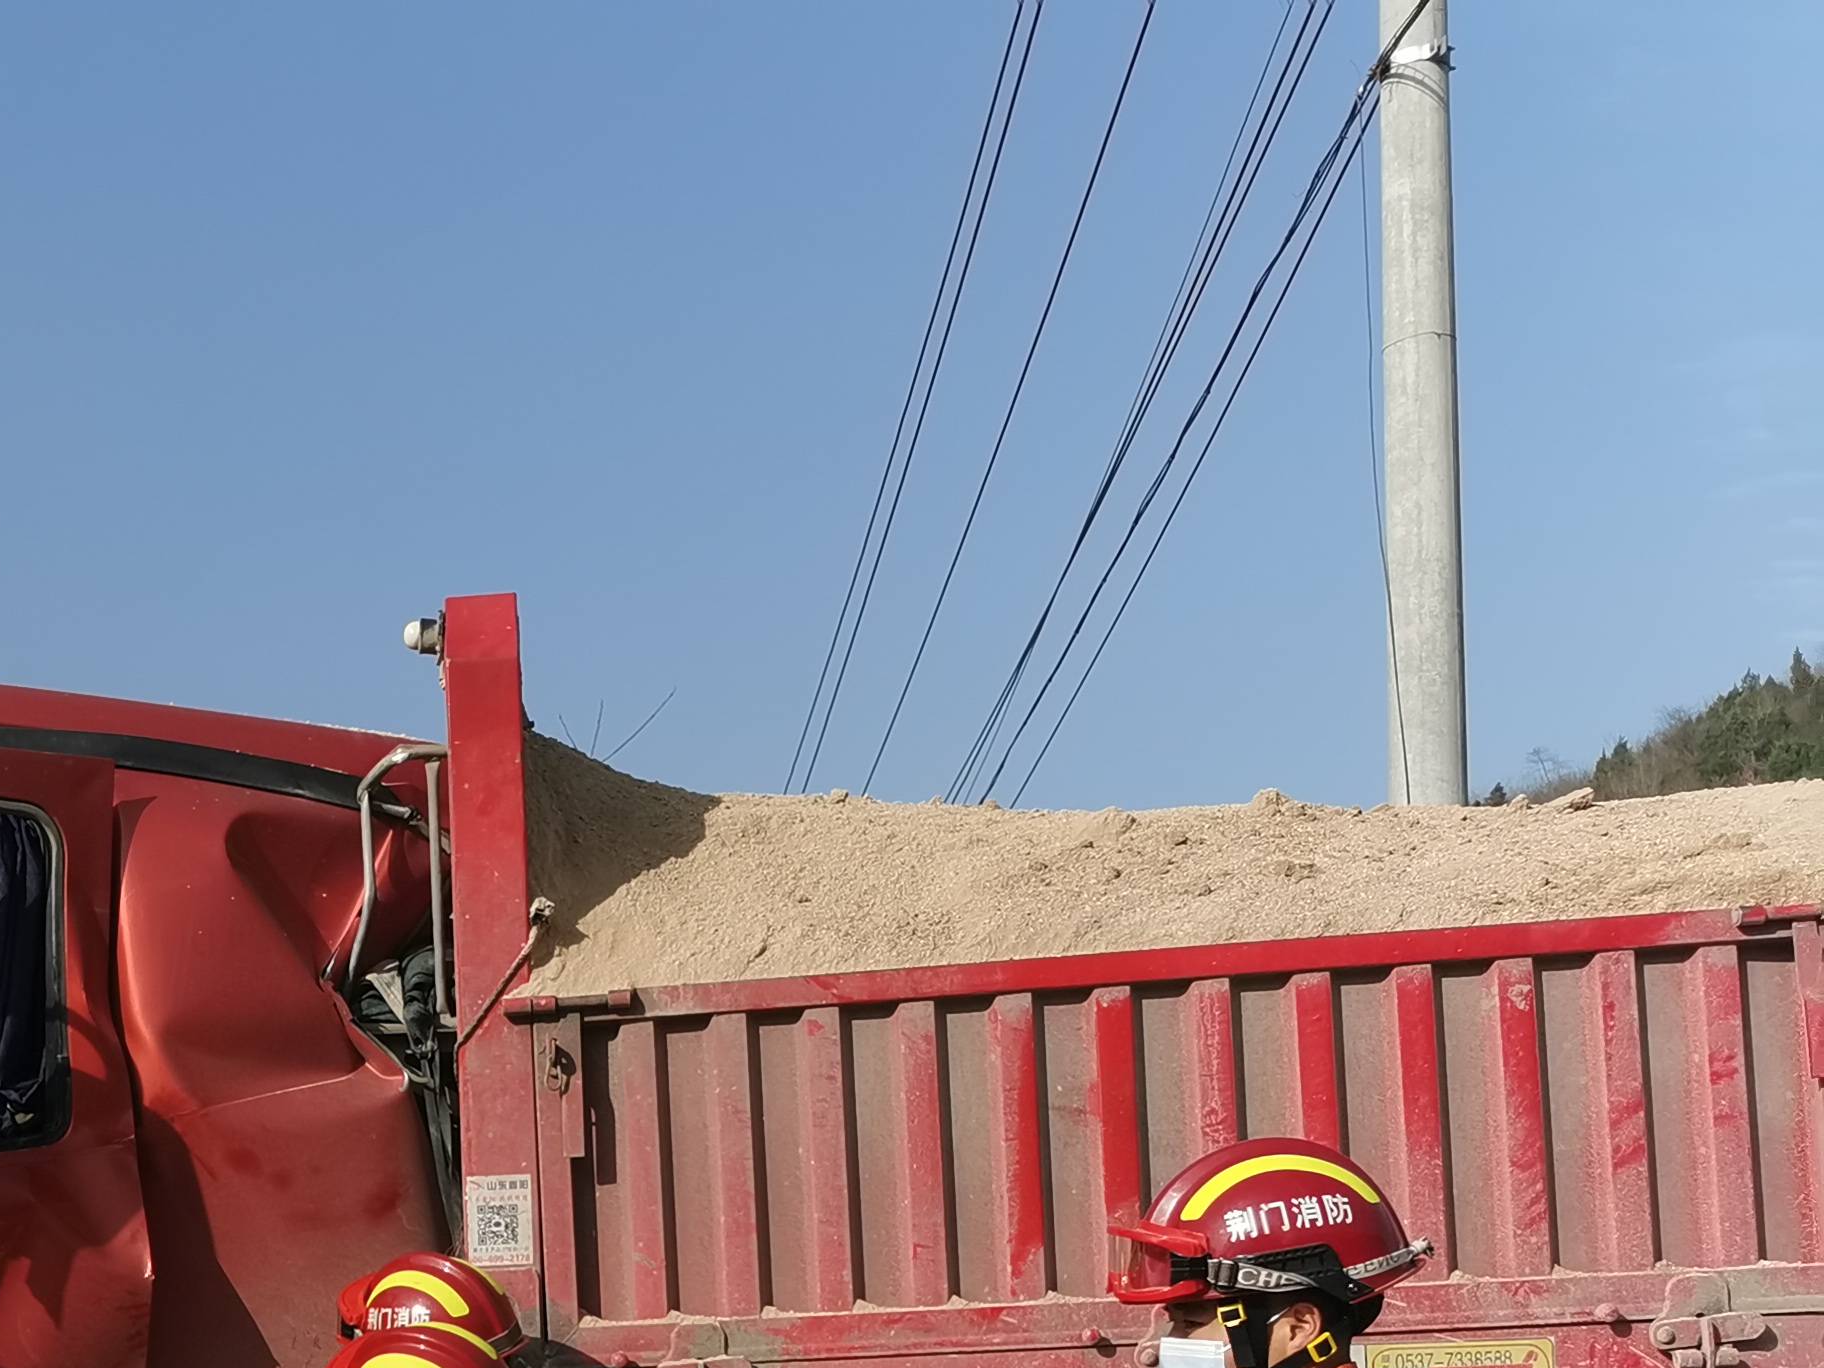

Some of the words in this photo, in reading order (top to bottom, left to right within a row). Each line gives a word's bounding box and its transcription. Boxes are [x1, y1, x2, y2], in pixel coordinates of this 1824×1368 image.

[1224, 1194, 1353, 1242] 荆门消防
[367, 1304, 430, 1330] 荆门消防
